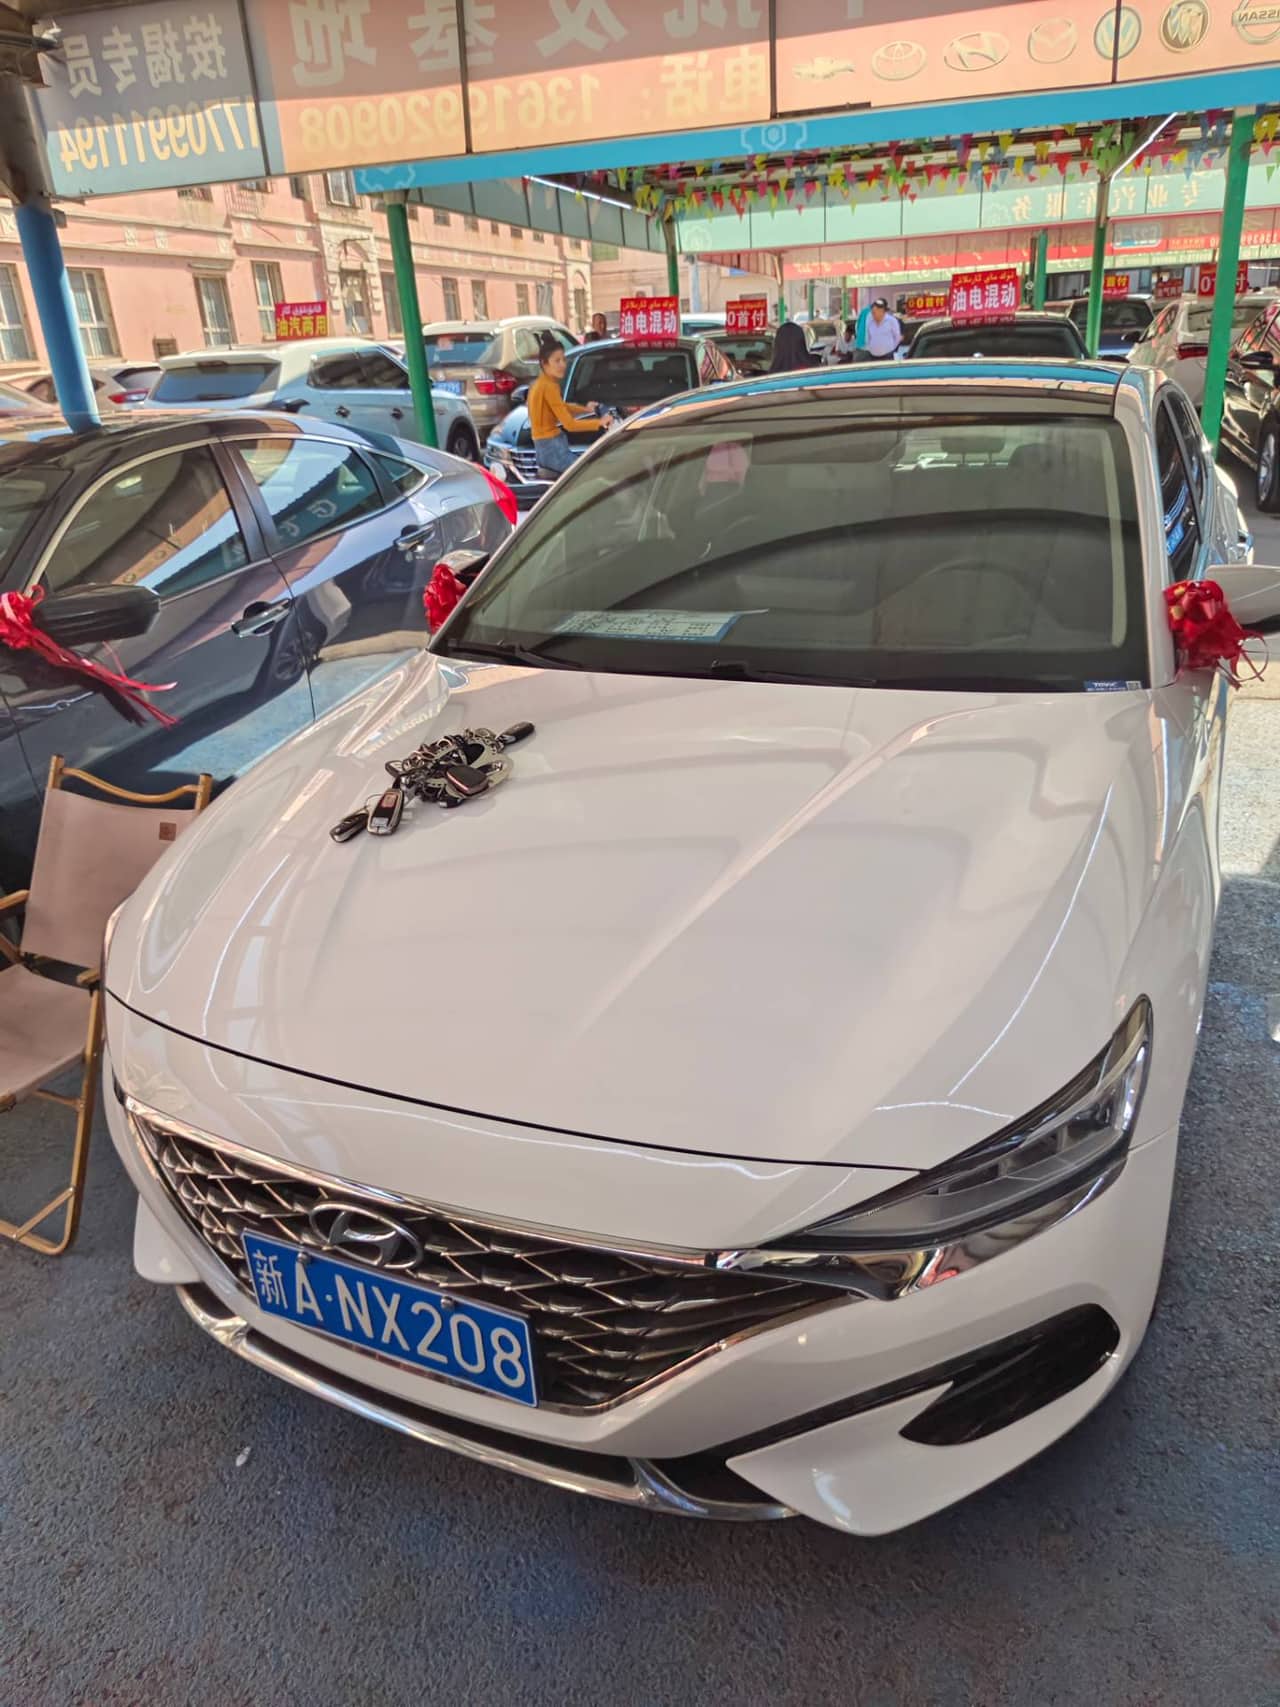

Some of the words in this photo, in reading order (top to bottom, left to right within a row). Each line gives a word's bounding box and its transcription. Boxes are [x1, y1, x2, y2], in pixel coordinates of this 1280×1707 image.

[952, 281, 1016, 313] 油电混动
[620, 310, 677, 335] 油电混动
[727, 308, 764, 329] 0首付
[252, 1249, 527, 1389] 新A·NX208
